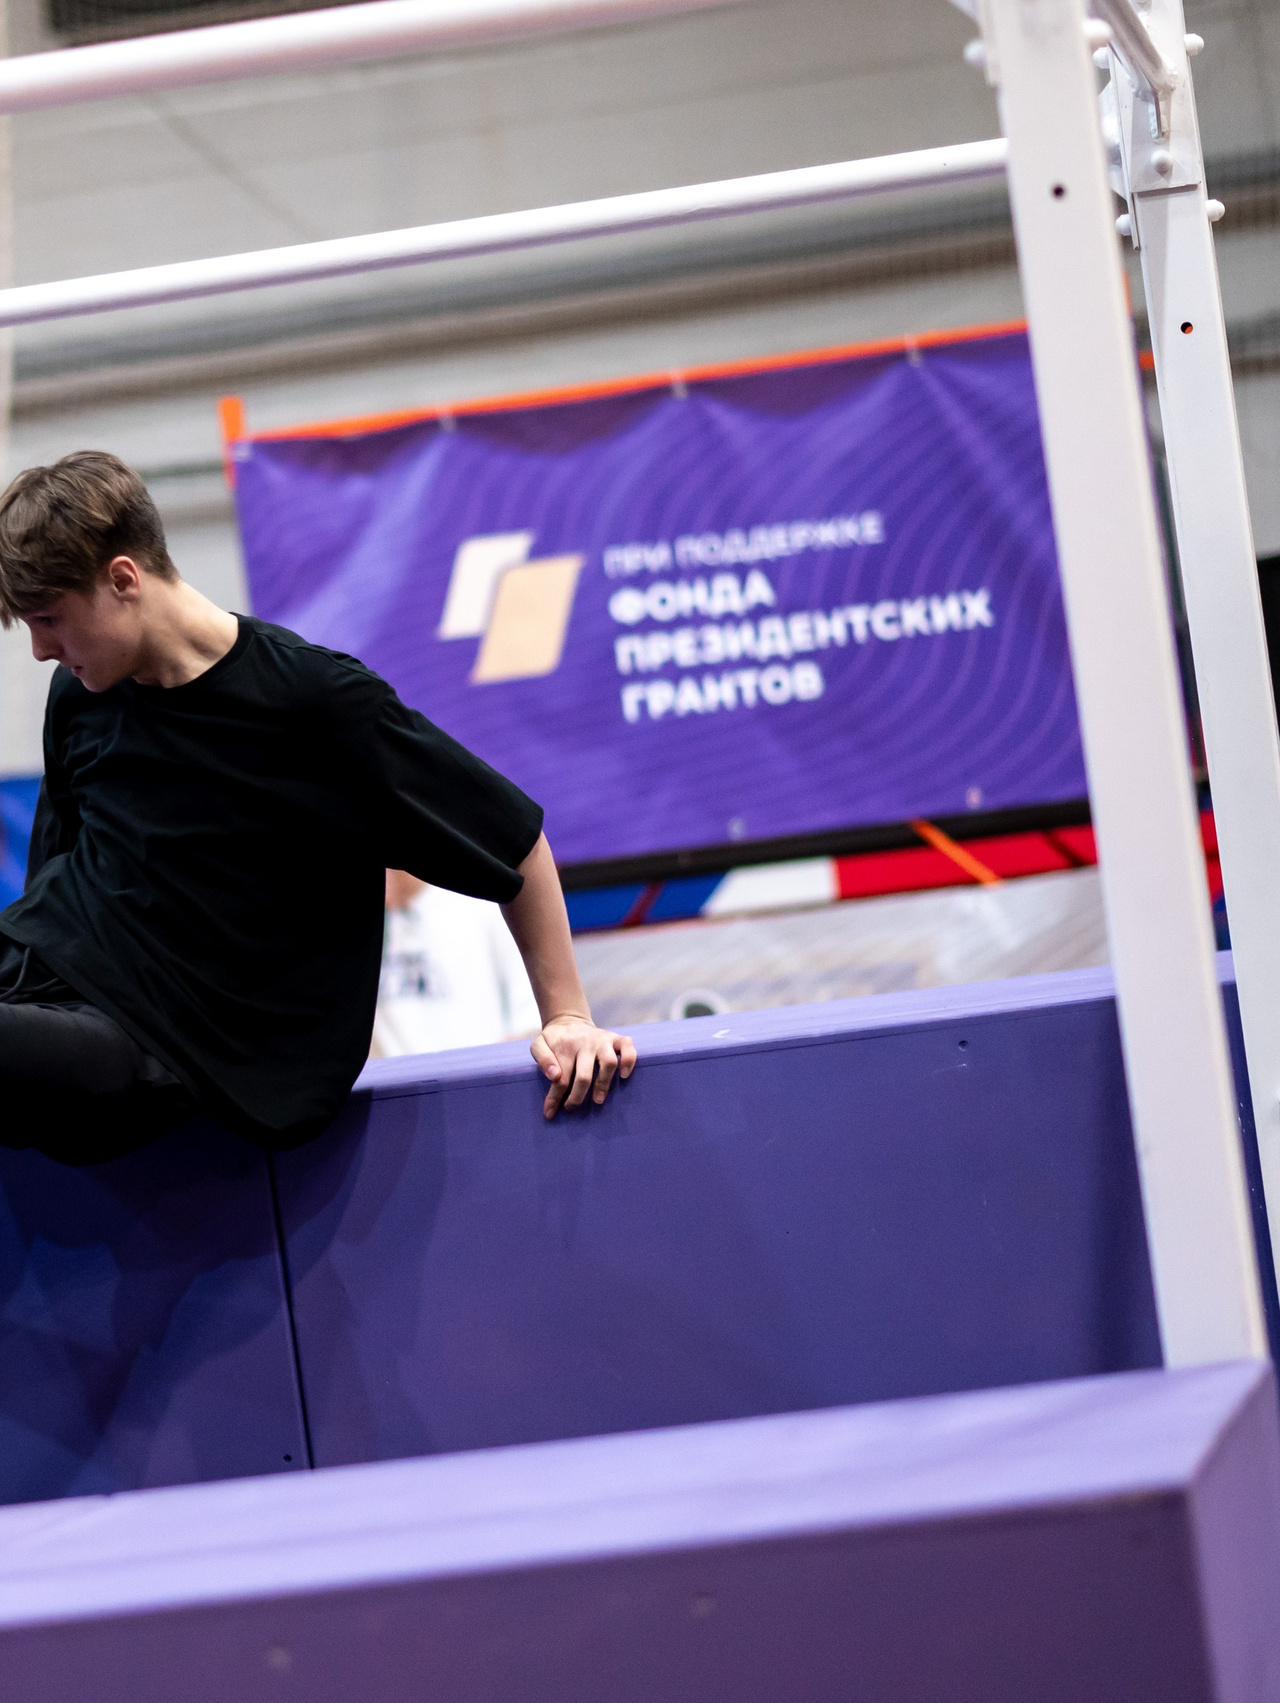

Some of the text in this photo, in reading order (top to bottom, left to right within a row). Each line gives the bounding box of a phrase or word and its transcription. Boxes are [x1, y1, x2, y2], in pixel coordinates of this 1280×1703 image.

[604, 511, 884, 577] ПРИ ПОДДЕРЖКЕ
[609, 569, 776, 625] ФОНДА
[614, 588, 994, 674] ПРЕЗИДЕНТСКИХ
[621, 661, 824, 723] ГРАНТОВ
